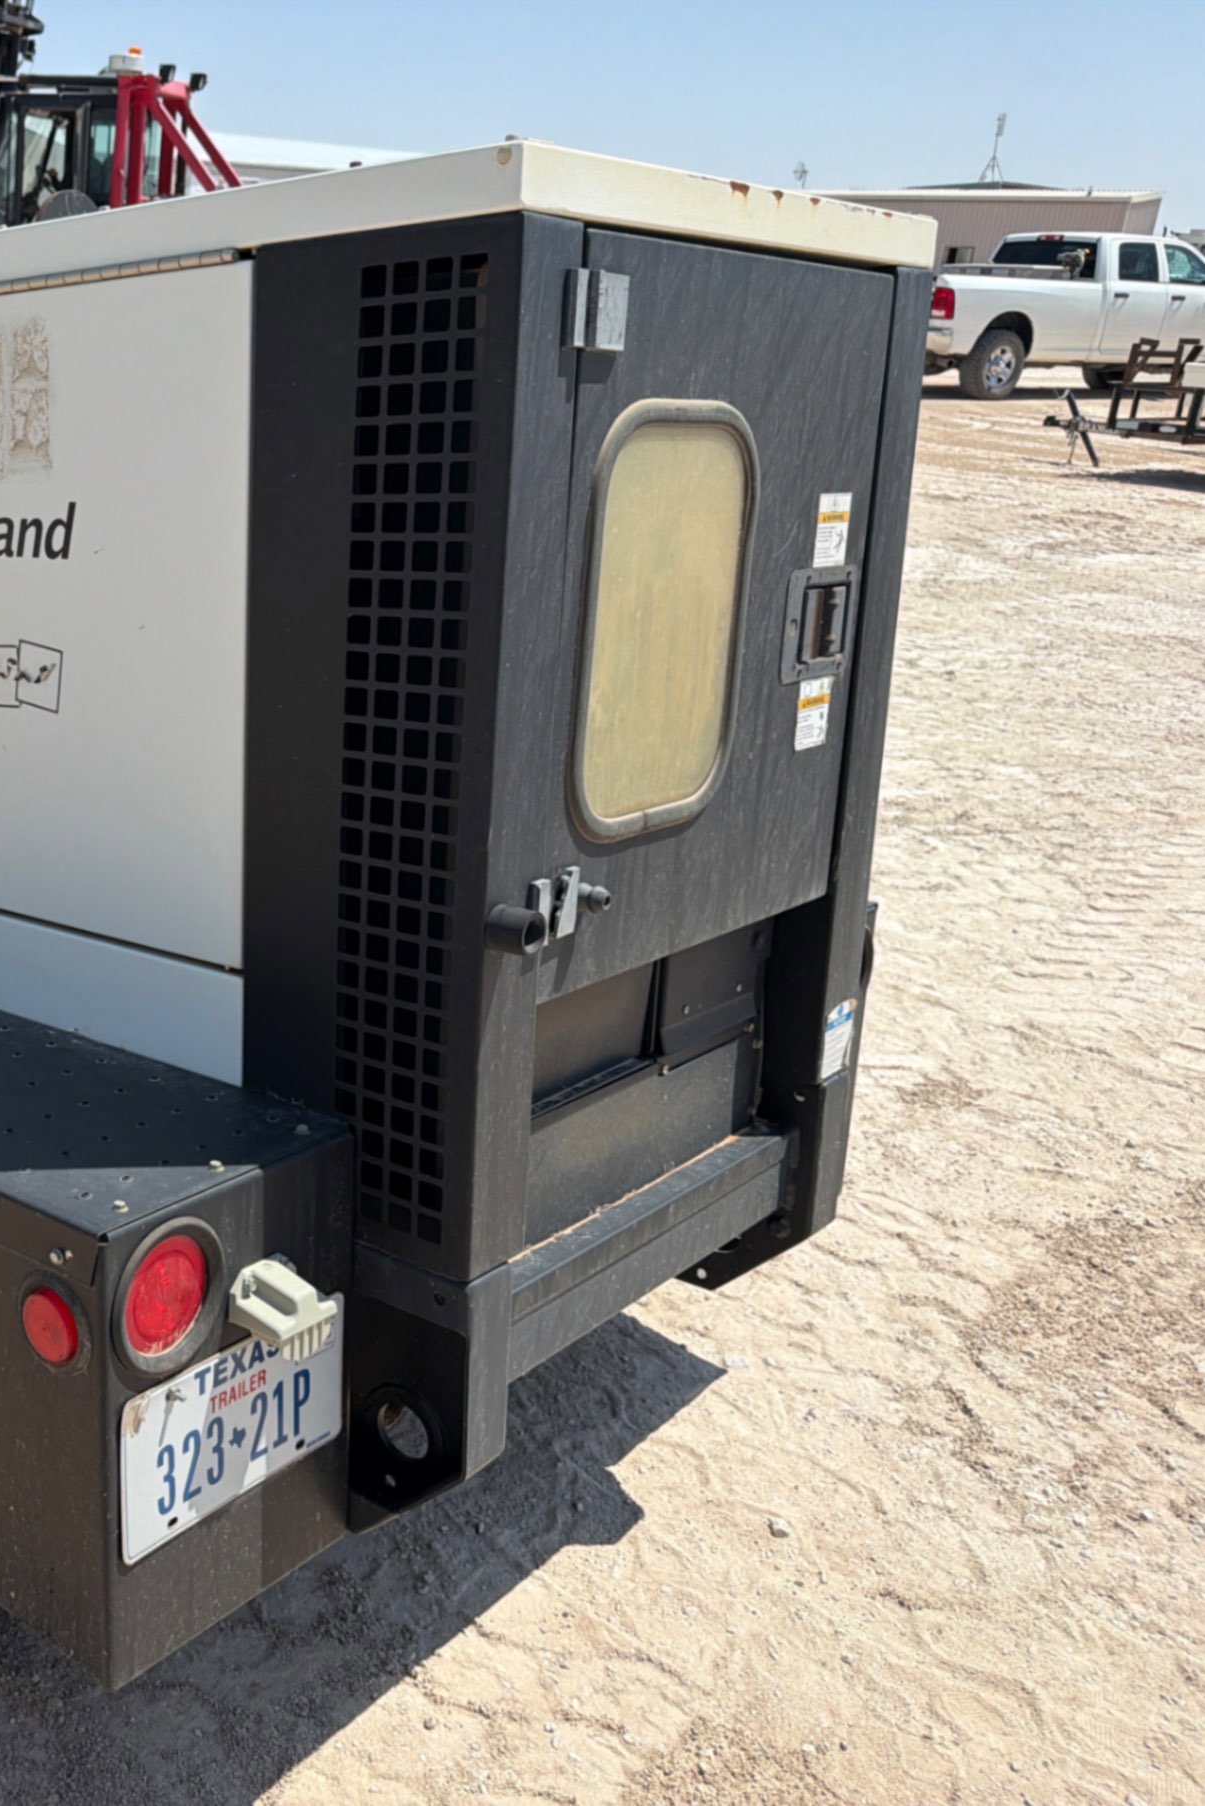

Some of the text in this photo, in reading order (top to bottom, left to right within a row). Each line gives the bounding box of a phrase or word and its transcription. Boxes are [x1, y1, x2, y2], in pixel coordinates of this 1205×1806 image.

[210, 1368, 267, 1415] TRAILER
[156, 1368, 311, 1516] 323 21P
